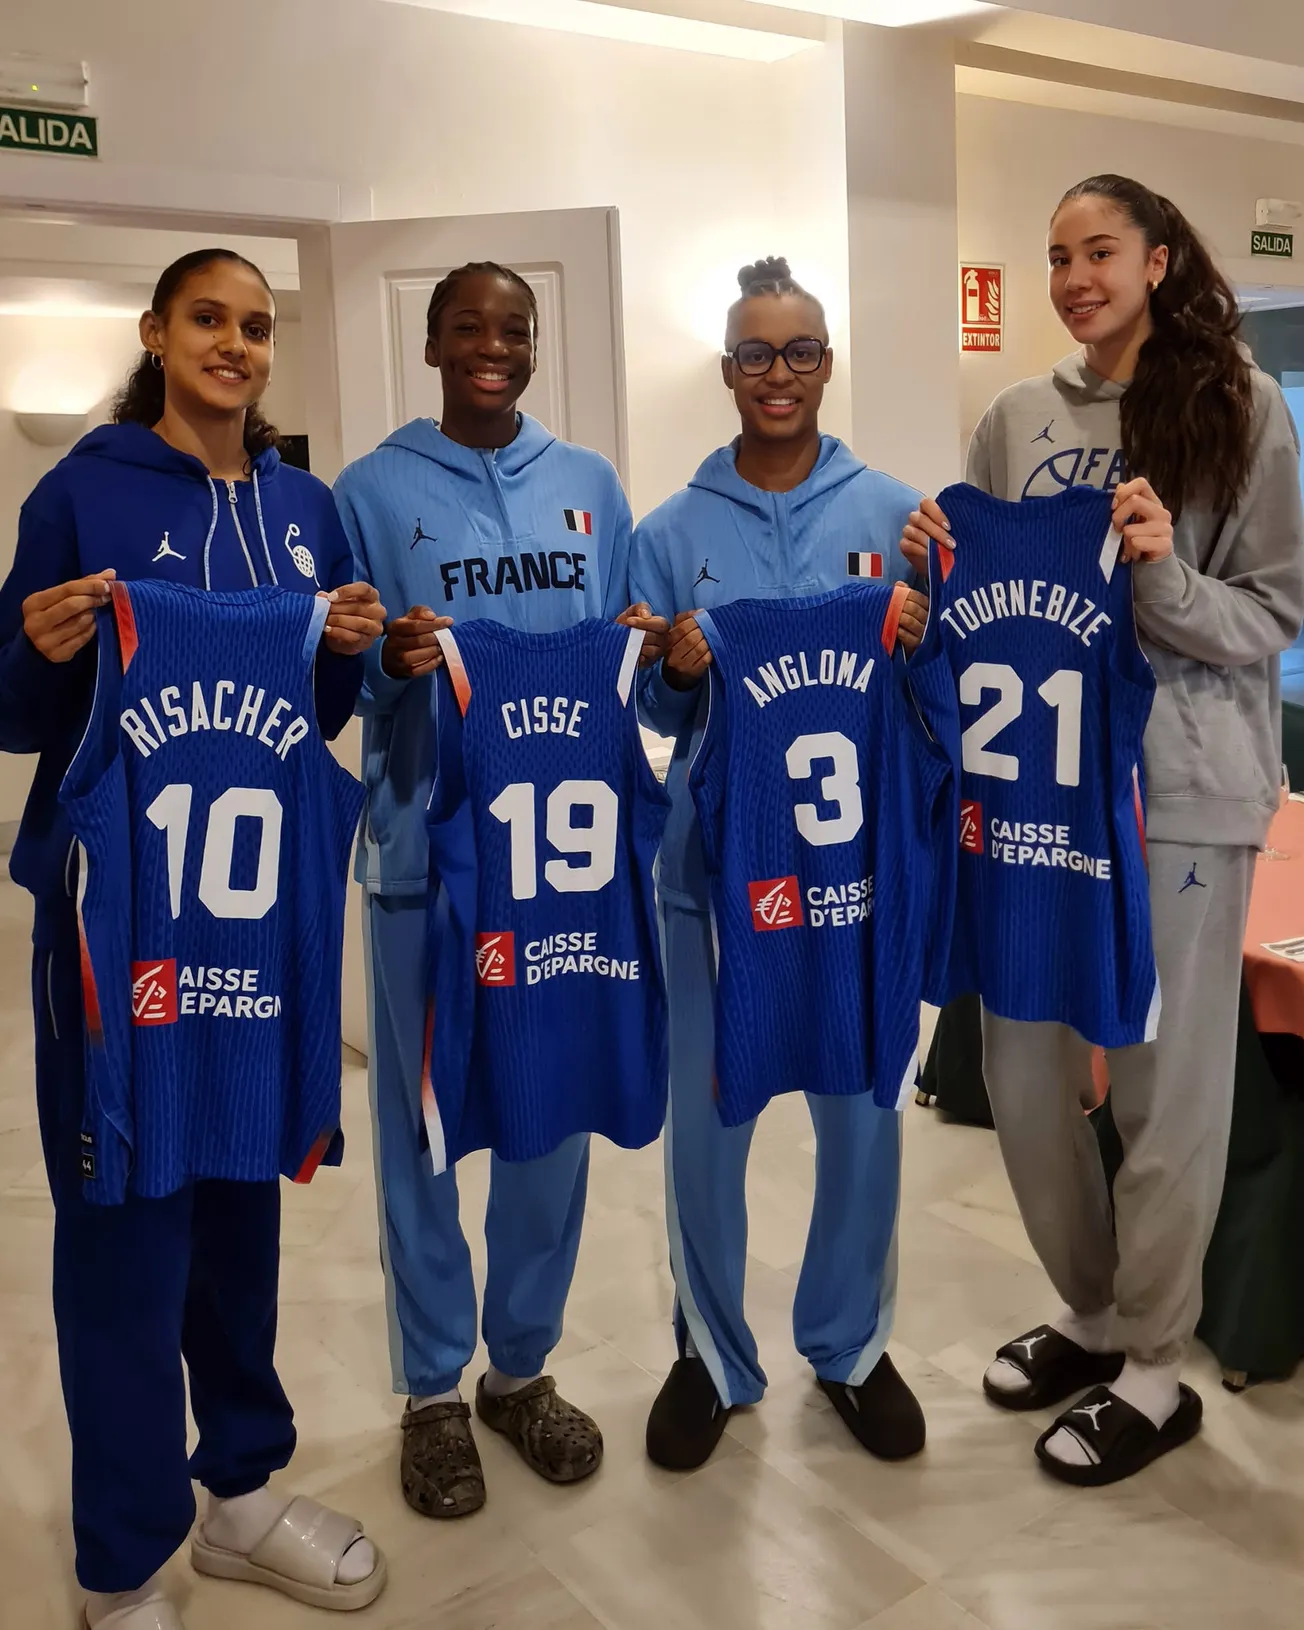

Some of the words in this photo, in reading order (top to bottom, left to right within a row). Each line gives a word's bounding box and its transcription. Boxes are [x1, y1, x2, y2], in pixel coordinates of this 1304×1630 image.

[0, 114, 93, 149] ALIDA
[1253, 235, 1291, 253] SALIDA
[963, 332, 1000, 347] EXTINTOR
[440, 551, 586, 601] FRANCE
[940, 579, 1112, 647] TOURNEBIZE
[743, 649, 875, 709] ANGLOMA
[120, 680, 309, 762] RISACHER
[501, 696, 589, 740] CISSE
[960, 662, 1083, 787] 21
[785, 731, 864, 847] 3
[488, 779, 619, 901] 19
[990, 817, 1070, 845] CAISSE
[145, 783, 283, 920] 10
[991, 839, 1111, 880] D'EPARGNE
[806, 875, 874, 906] CAISSE
[809, 898, 875, 928] D'EPAR
[524, 932, 597, 962] CAISSE
[178, 965, 259, 992] AISSE
[526, 954, 640, 986] D'EPARGNE
[180, 991, 282, 1019] EPARGN
